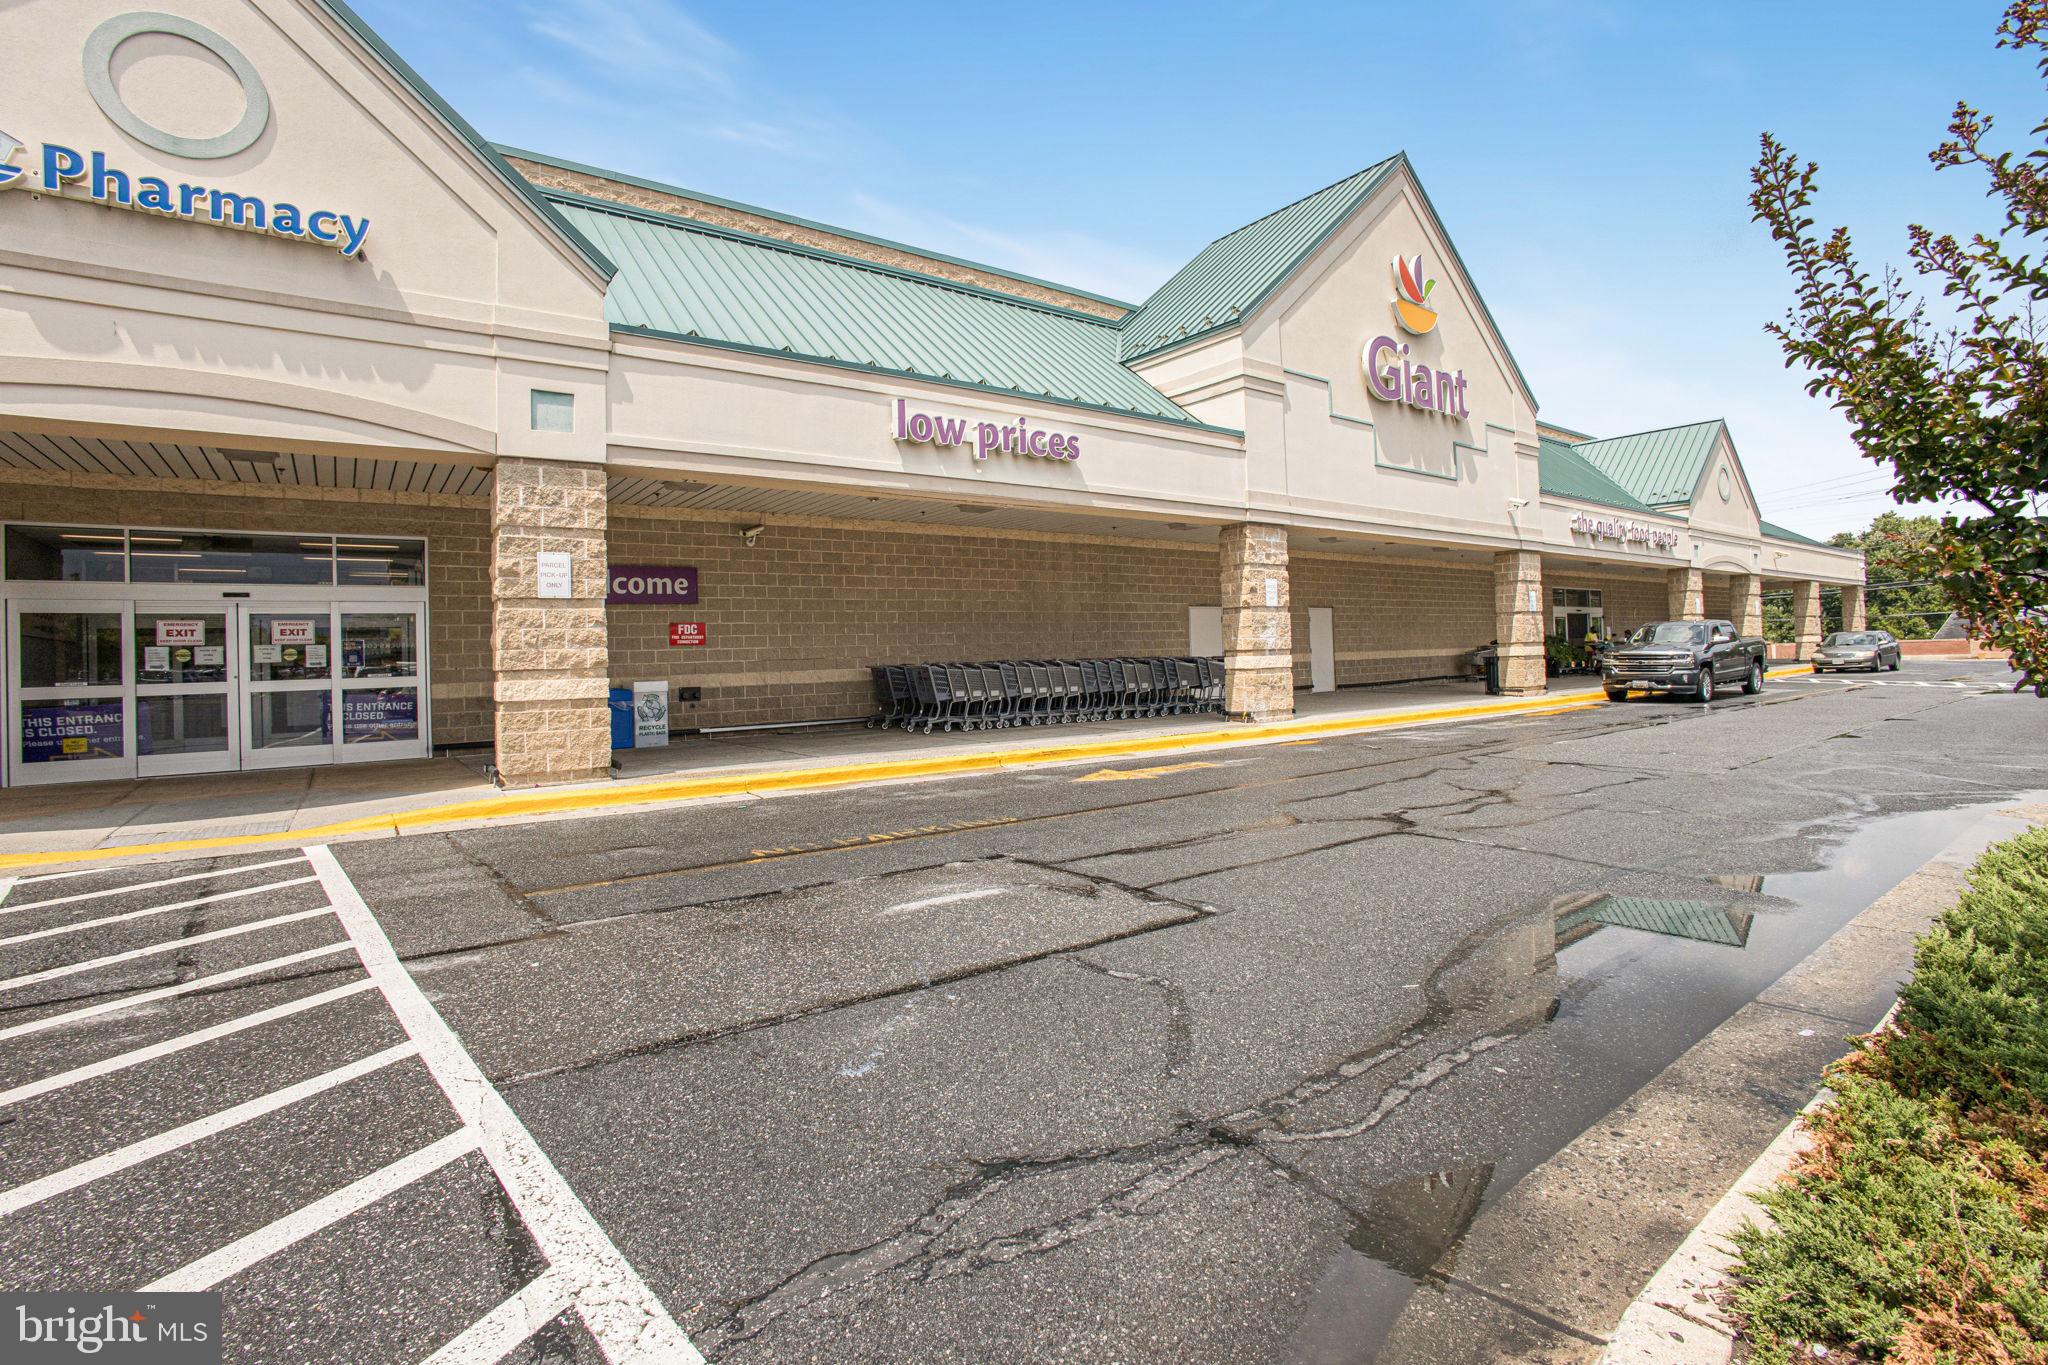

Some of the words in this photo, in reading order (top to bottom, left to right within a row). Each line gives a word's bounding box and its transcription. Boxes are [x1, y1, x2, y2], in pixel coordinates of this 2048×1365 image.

[41, 142, 370, 256] Pharmacy
[1367, 336, 1470, 420] Giant
[894, 399, 967, 446] low
[975, 416, 1081, 461] prices
[1576, 511, 1594, 534] the
[1596, 517, 1628, 543] quality
[1630, 521, 1650, 543] food
[1652, 528, 1678, 549] people
[606, 569, 689, 595] lcome
[166, 629, 197, 638] EXIT
[280, 628, 308, 637] EXIT
[678, 624, 698, 635] FDC
[328, 703, 353, 711] TIS
[356, 702, 414, 711] ENTRANCE
[56, 713, 123, 726] ENTRANC
[343, 711, 386, 721] CLOSED.
[38, 725, 97, 737] CLOSED.
